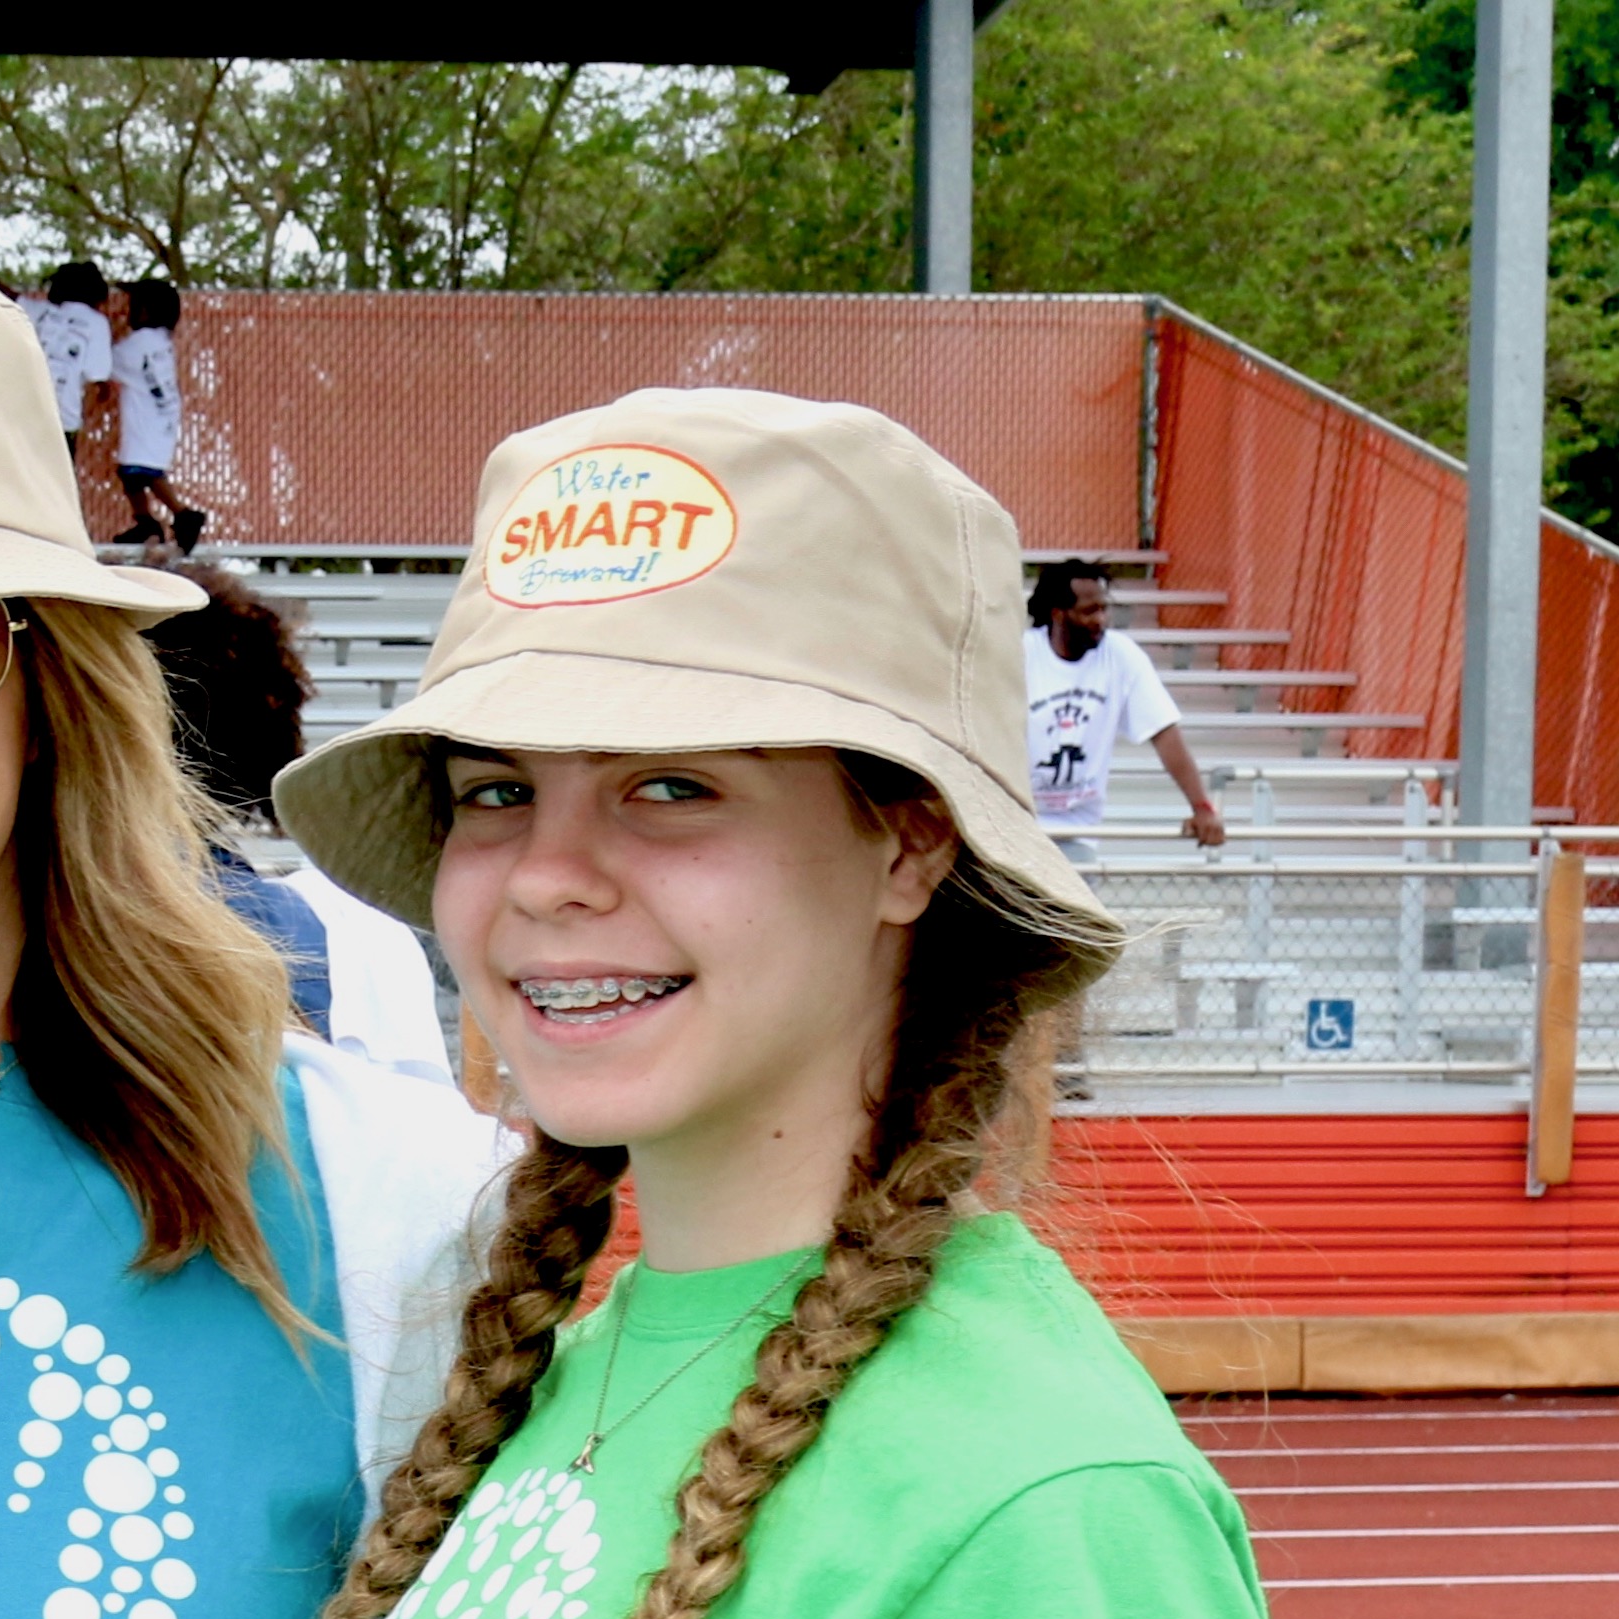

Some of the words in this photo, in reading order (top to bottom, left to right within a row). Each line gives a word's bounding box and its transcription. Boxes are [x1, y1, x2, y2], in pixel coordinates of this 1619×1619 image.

[552, 460, 651, 499] Water
[501, 499, 714, 565] SMART
[519, 551, 661, 597] Broward!
